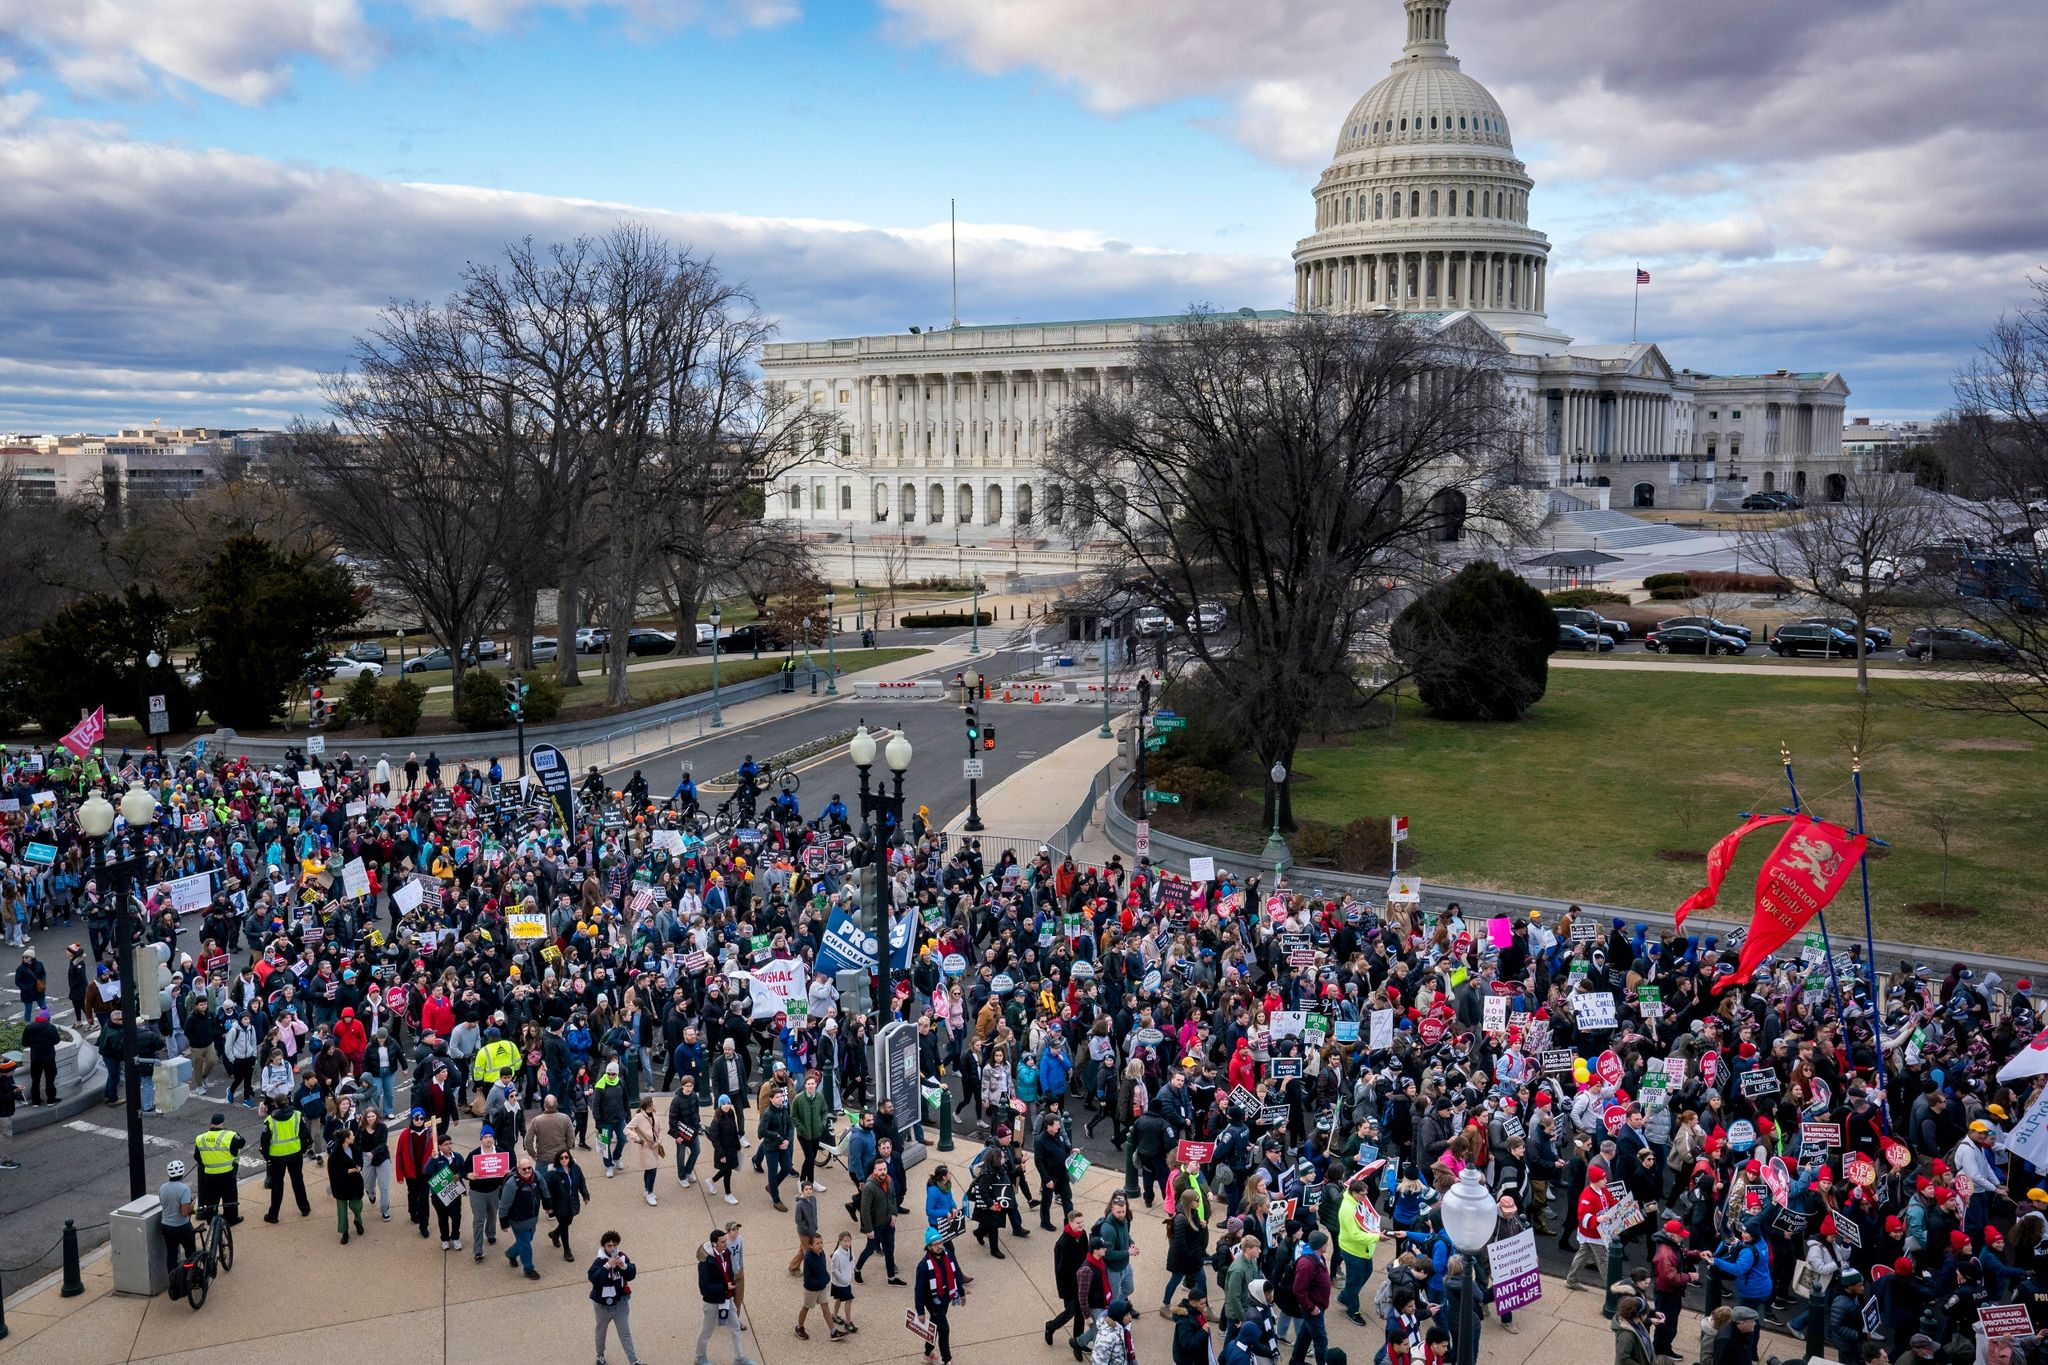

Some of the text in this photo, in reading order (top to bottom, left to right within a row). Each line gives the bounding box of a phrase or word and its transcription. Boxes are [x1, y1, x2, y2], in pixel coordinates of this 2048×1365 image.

[1144, 738, 1162, 748] CAPITOL
[545, 777, 567, 785] Impacted
[1163, 882, 1188, 891] UNBORN
[1760, 896, 1796, 931] operty
[826, 935, 872, 966] CHALDEAN
[1580, 1019, 1603, 1027] HUMAN
[1600, 1057, 1614, 1068] LOVE
[1603, 1064, 1618, 1074] BOTH
[1746, 1076, 1777, 1086] Abundant
[1888, 1151, 1909, 1160] LIFE
[430, 1167, 451, 1187] LOVE LIFE
[1850, 1168, 1873, 1177] LIFE
[441, 1182, 458, 1197] CHOOSE
[448, 1190, 459, 1200] LIFE
[1269, 1214, 1284, 1223] SAVE
[1496, 1239, 1520, 1251] Abortion
[1497, 1242, 1533, 1260] Contraception
[1498, 1253, 1530, 1270] Sterilization
[1510, 1266, 1523, 1276] ARE
[1496, 1273, 1538, 1298] ANTI-GOD
[1984, 1318, 2028, 1326] PROTECTION
